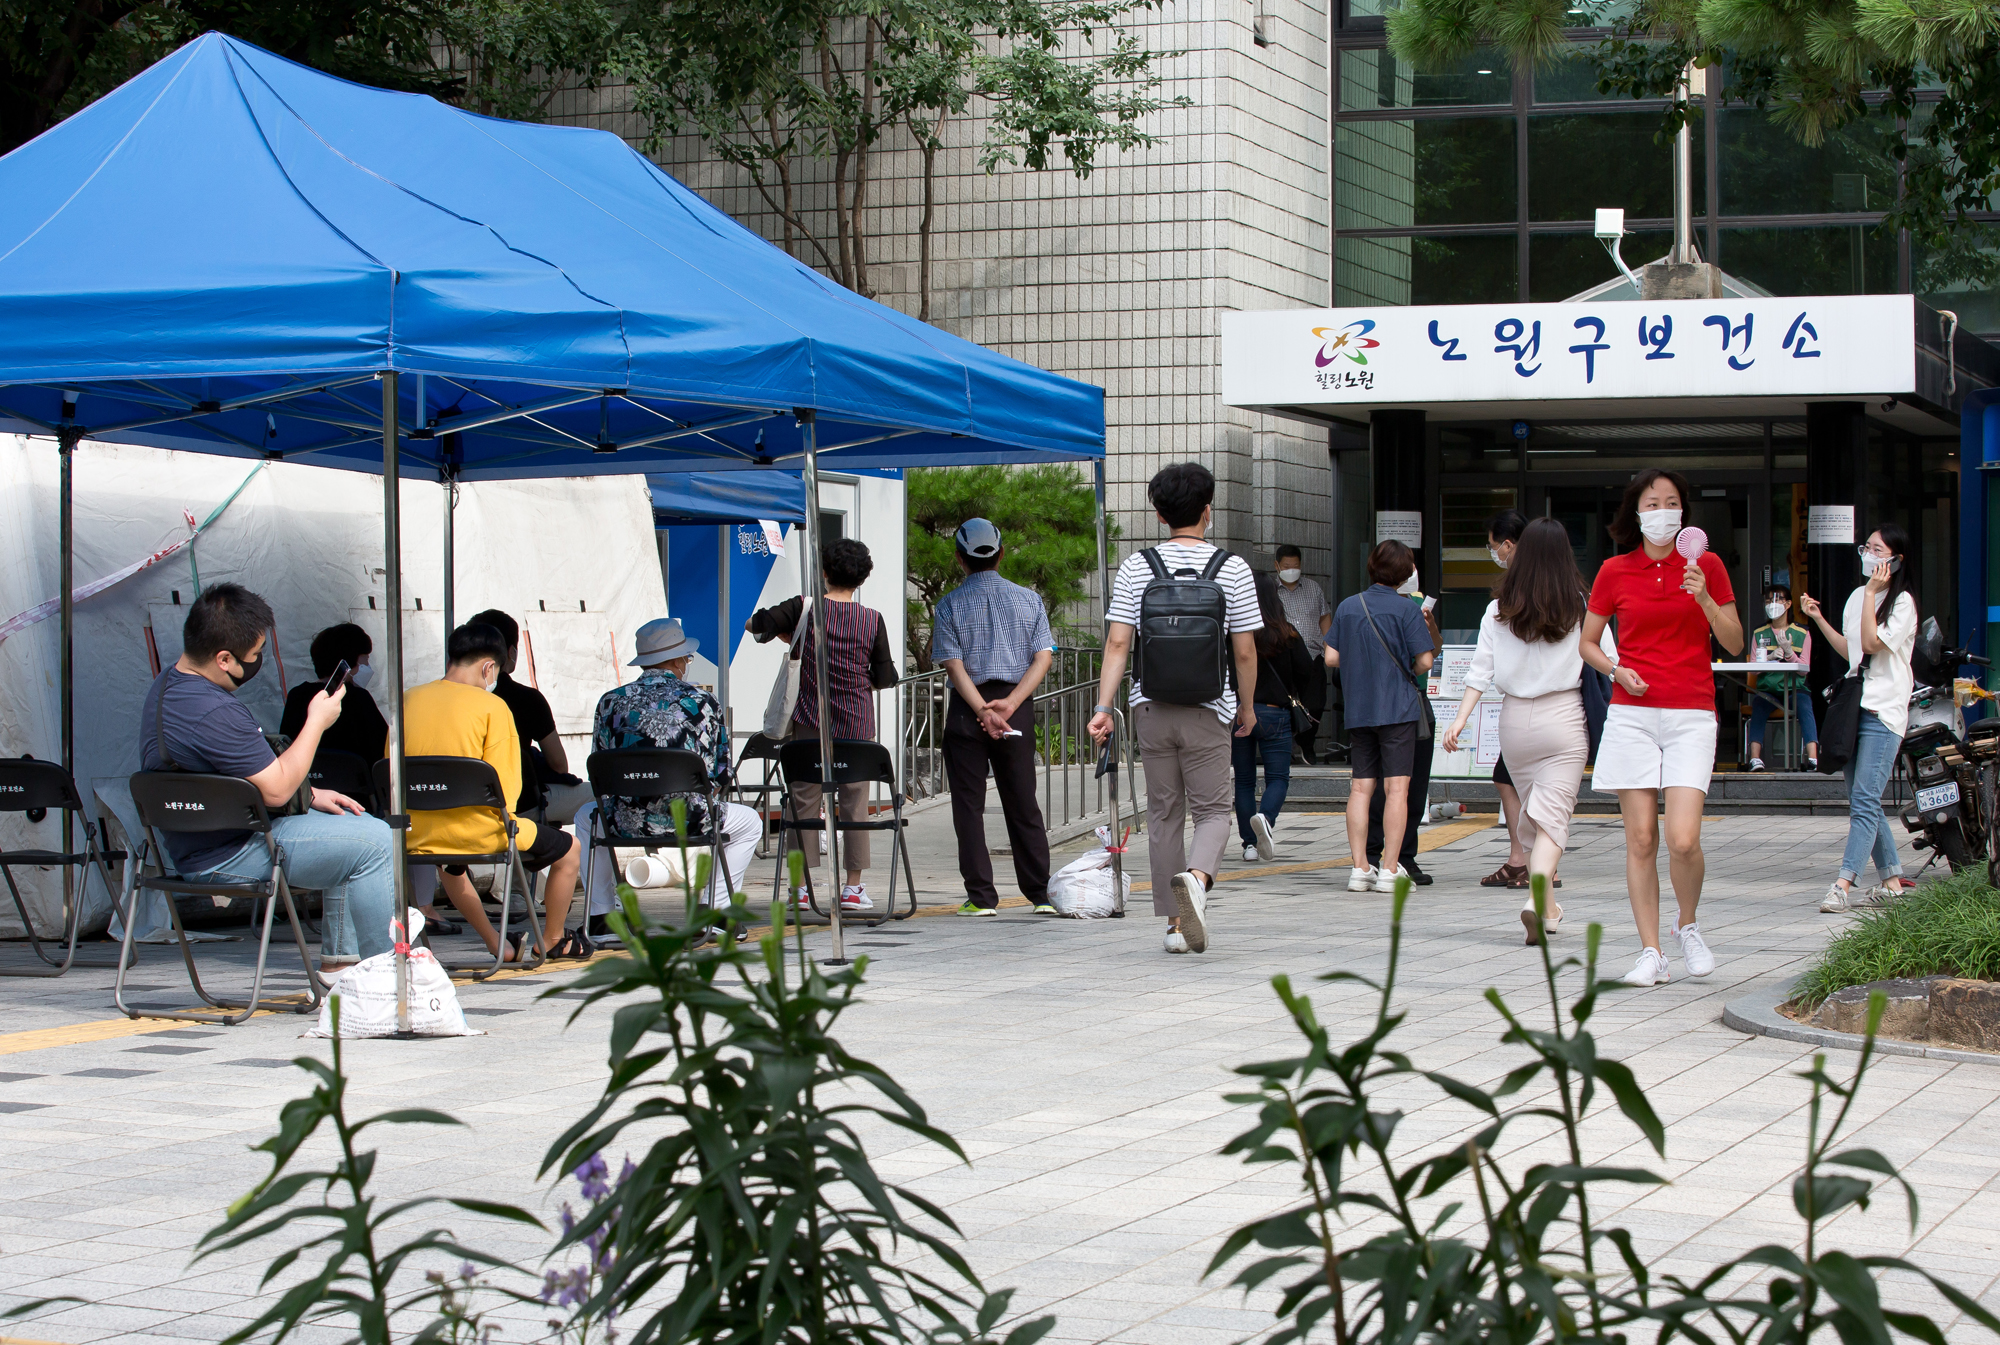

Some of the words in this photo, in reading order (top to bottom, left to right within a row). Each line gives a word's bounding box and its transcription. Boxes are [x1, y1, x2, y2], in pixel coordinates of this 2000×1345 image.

[1428, 311, 1821, 384] 노원구보건소
[1314, 370, 1342, 390] 힐링
[1345, 370, 1374, 390] 노원
[623, 772, 641, 780] 노원구
[8, 785, 25, 793] 보건소
[1928, 792, 1955, 806] 3606
[164, 801, 184, 810] 노원구
[185, 802, 206, 811] 보건소
